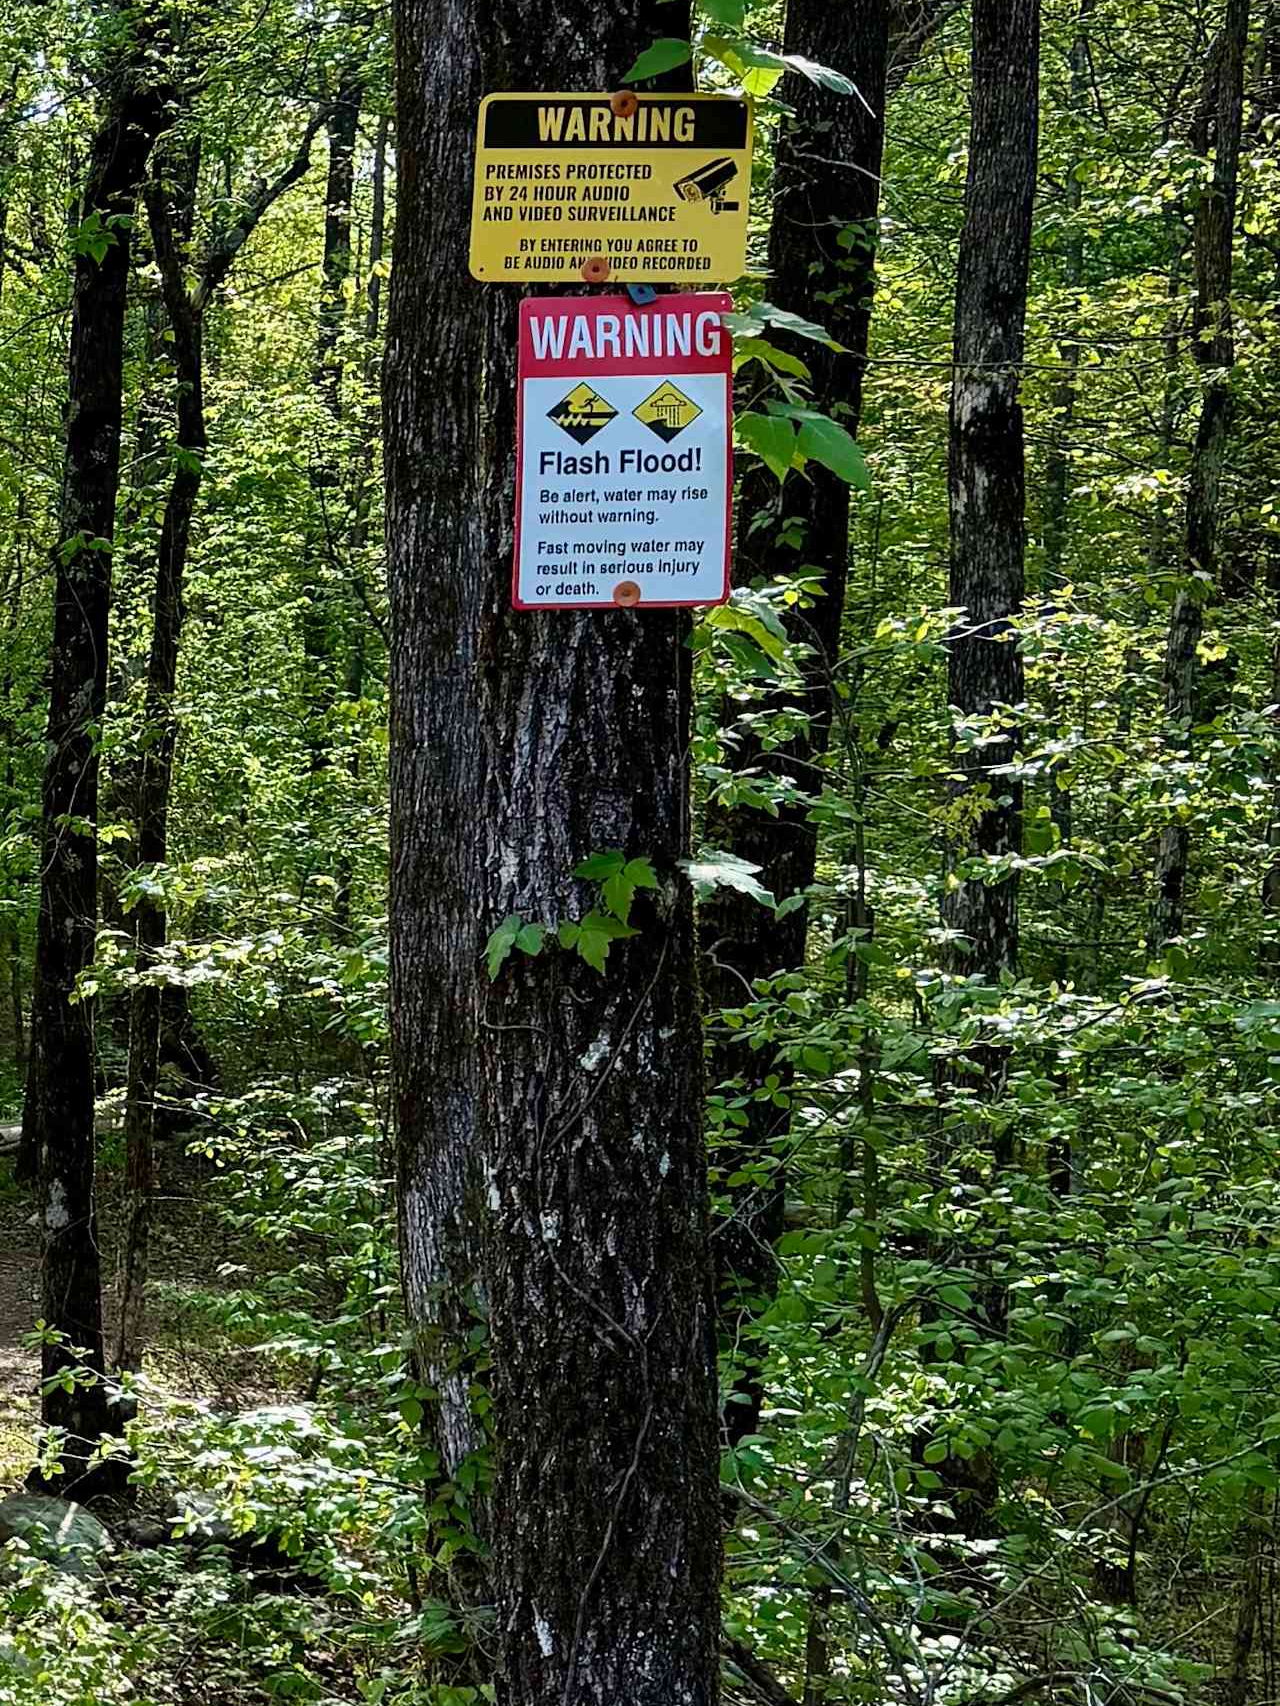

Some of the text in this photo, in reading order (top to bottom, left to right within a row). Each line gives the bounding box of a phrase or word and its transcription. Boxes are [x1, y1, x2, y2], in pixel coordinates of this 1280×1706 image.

[538, 106, 696, 142] WARNING
[486, 164, 652, 180] PREMISES PROTECTED
[484, 185, 630, 201] BY 24 HOUR AUDIO
[483, 206, 676, 222] AND VIDEO SURVEILLANCE
[519, 239, 698, 252] BY ENTERING YOU AGREE TO
[504, 256, 711, 270] BE AUDIO AN IDEO RECORDED
[529, 311, 721, 360] WARNING
[539, 448, 703, 475] Flash Flood!
[539, 487, 708, 505] Be alert, water may rise
[539, 509, 659, 525] without warning.
[538, 540, 704, 557] Fast moving water may
[536, 559, 700, 575] result in serious injury
[536, 582, 599, 596] or death.
